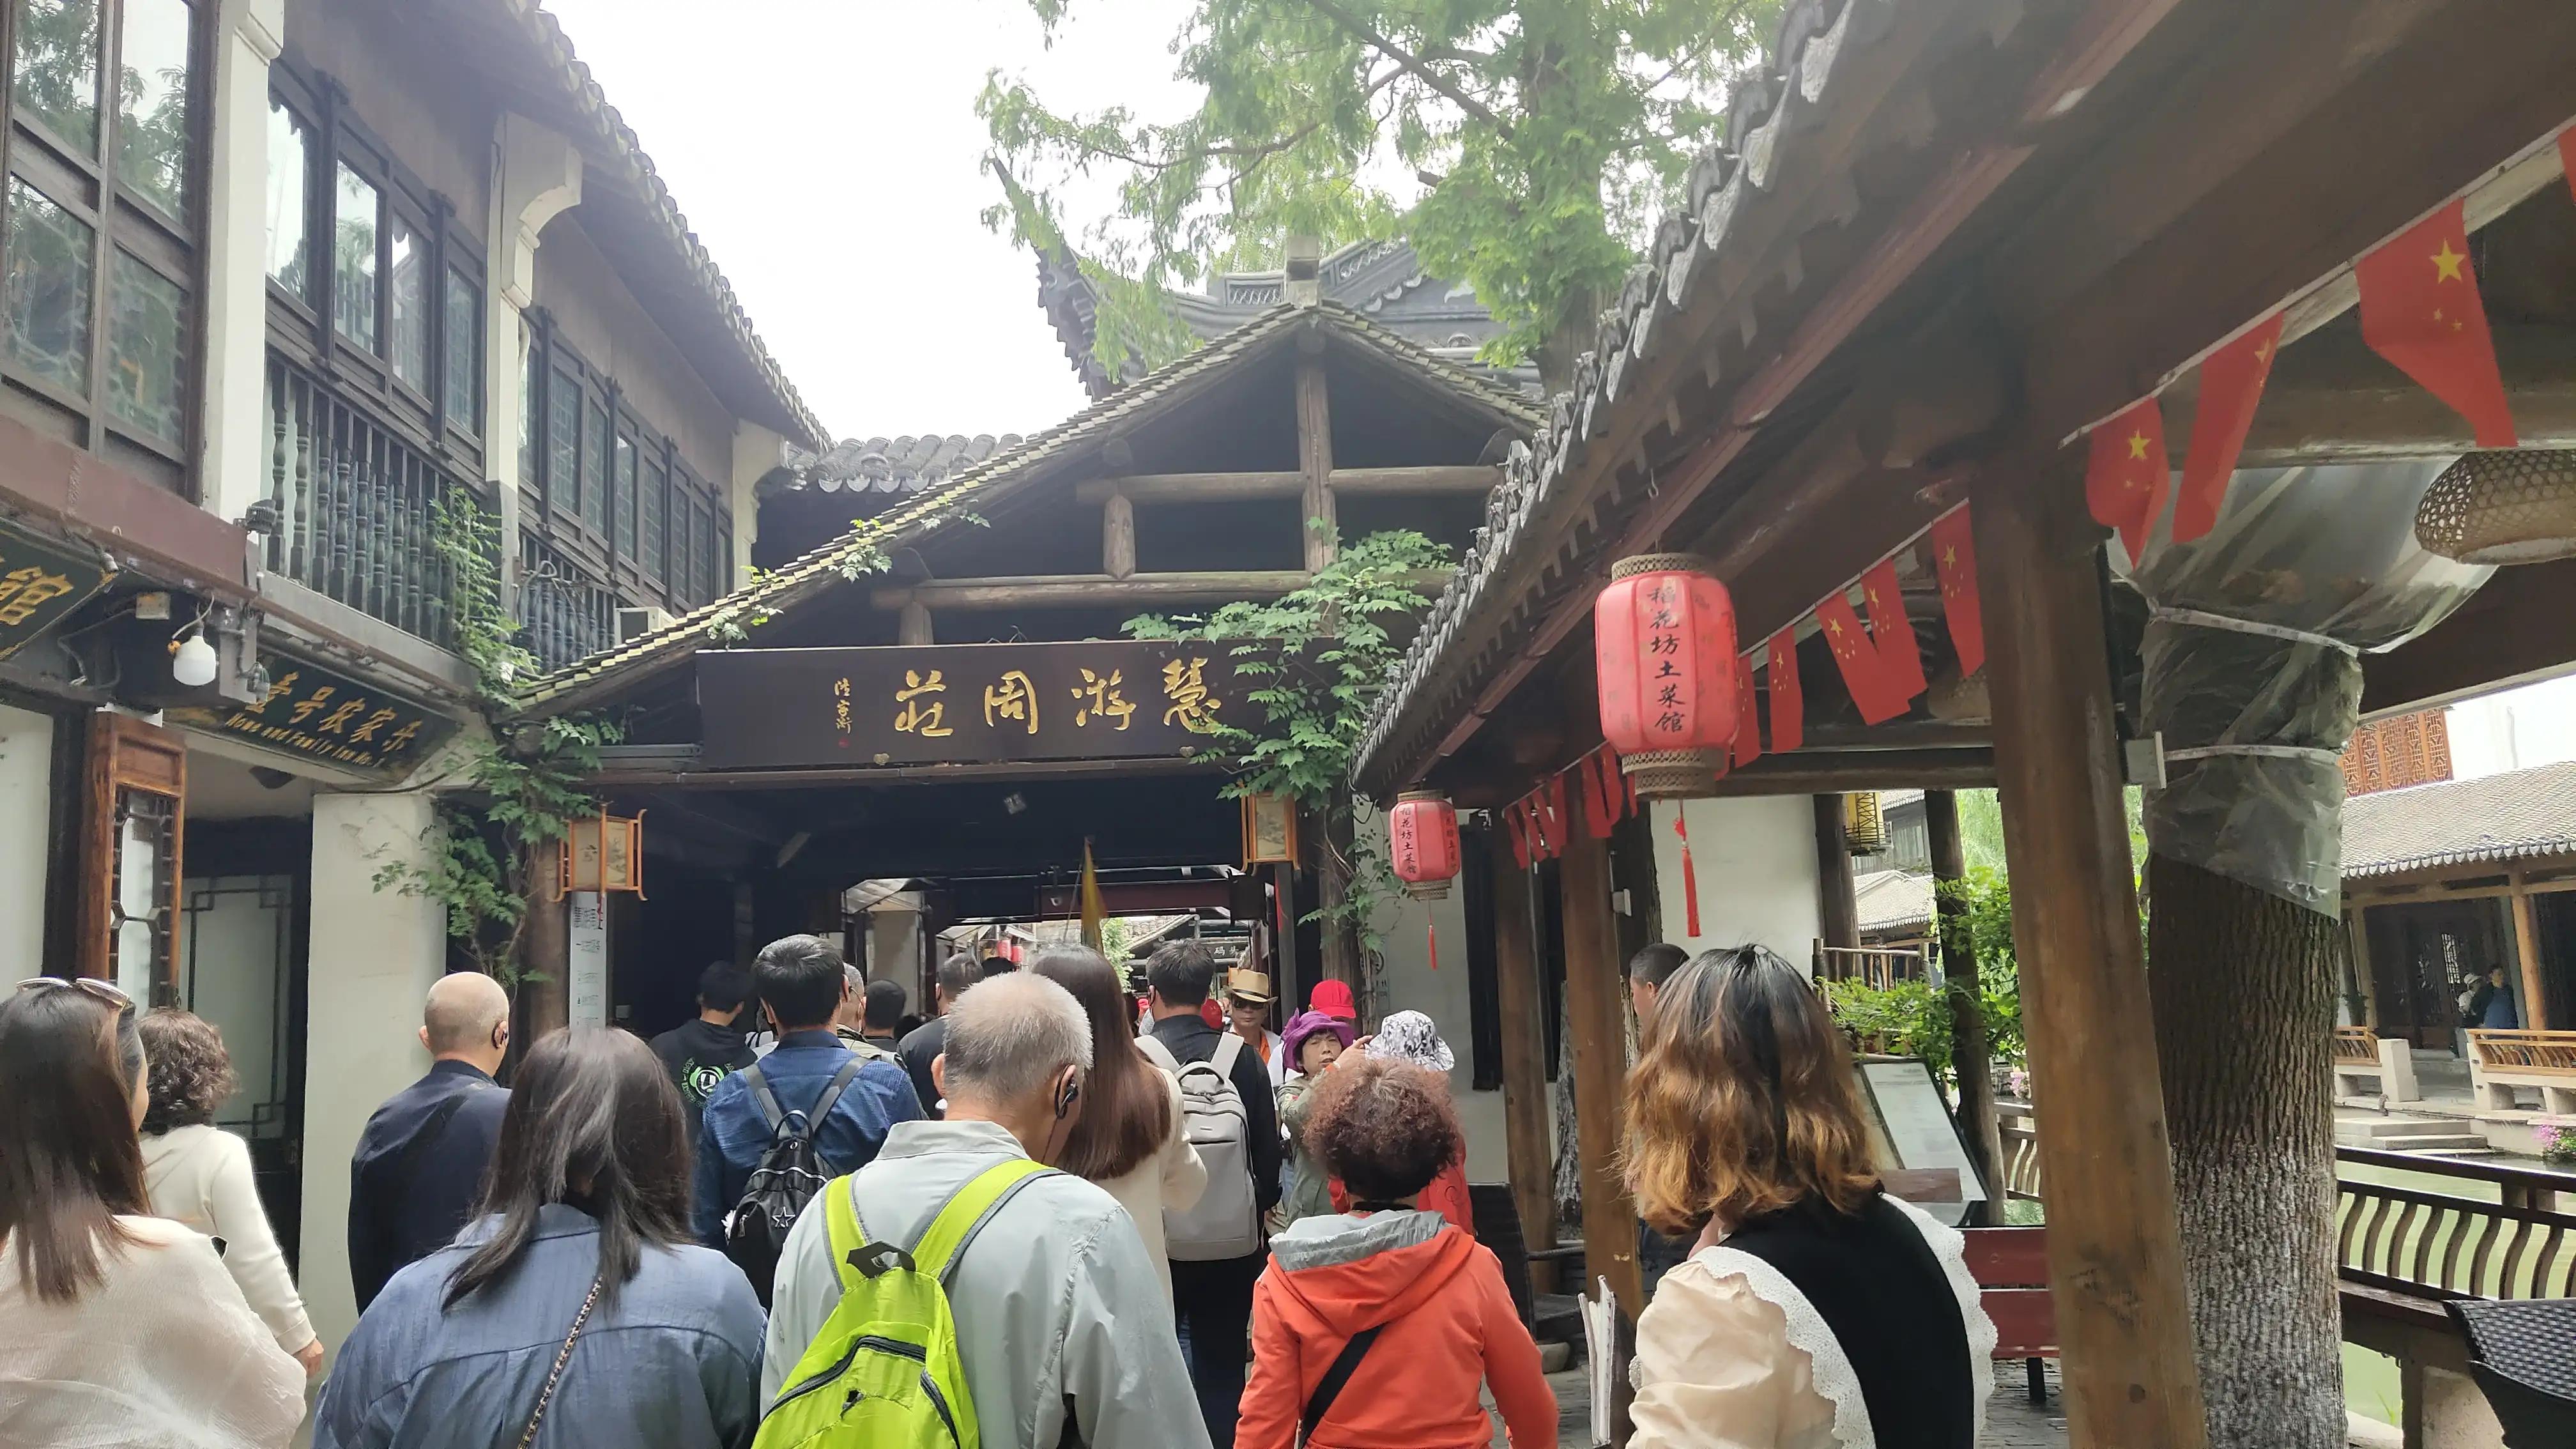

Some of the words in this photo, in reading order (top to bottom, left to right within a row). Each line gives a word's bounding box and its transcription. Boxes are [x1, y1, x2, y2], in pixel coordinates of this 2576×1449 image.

[1648, 586, 1685, 733] 稻花坊土菜馆
[260, 726, 293, 741] and
[285, 731, 335, 755] Family
